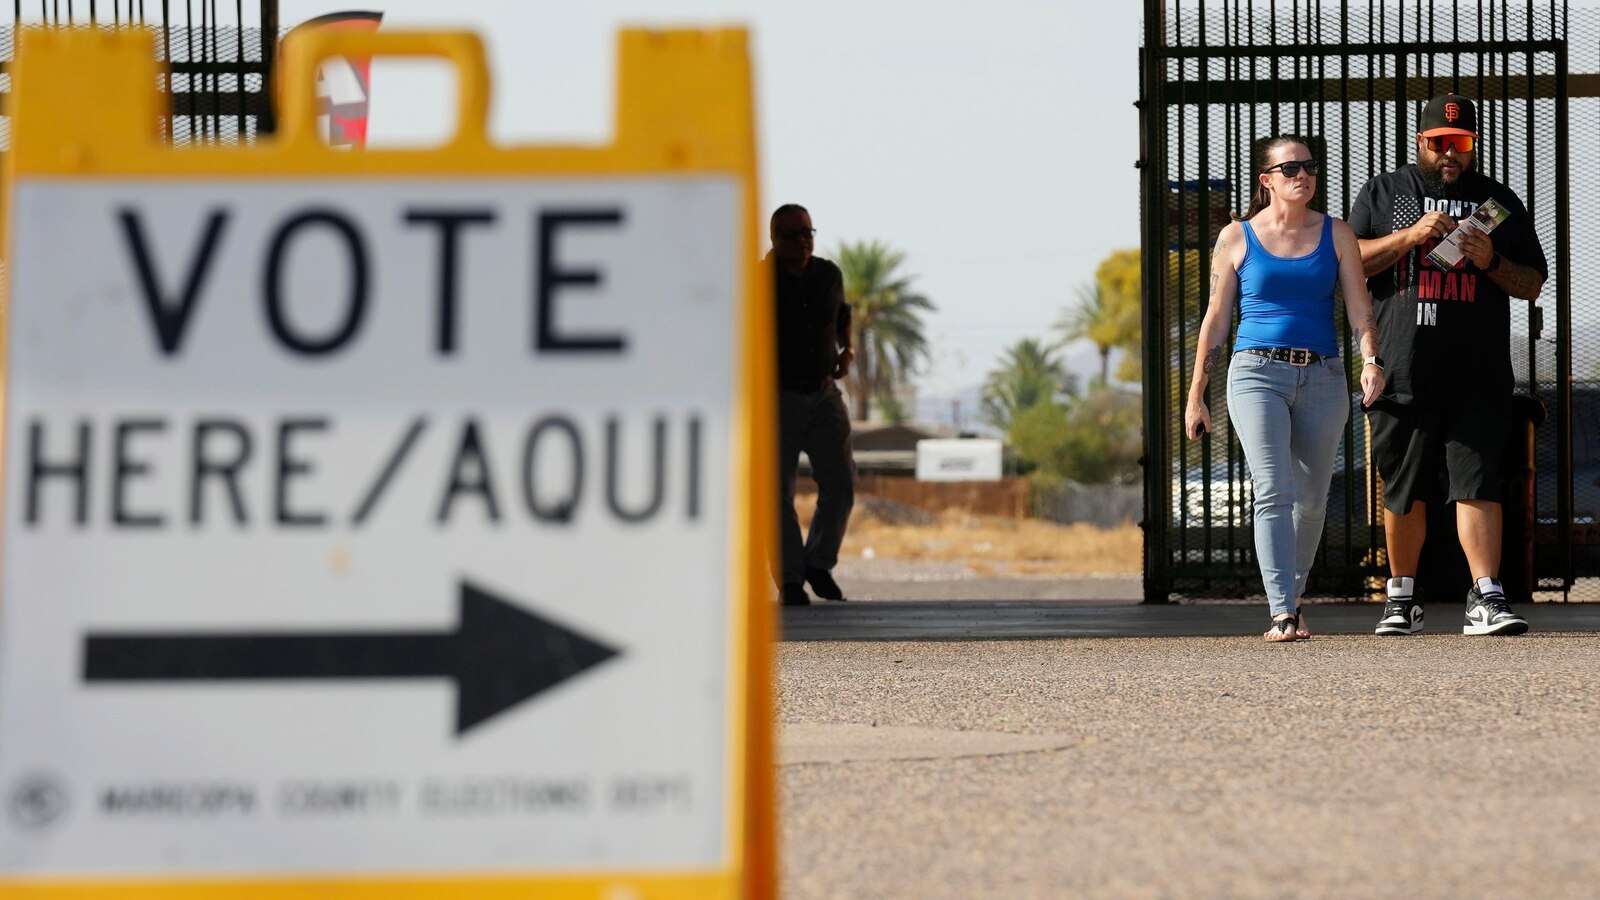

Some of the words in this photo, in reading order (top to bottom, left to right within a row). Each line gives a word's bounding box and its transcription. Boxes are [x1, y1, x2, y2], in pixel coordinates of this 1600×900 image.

[1423, 196, 1479, 217] DON'T
[112, 203, 632, 363] VOTE
[1418, 270, 1476, 303] MAN
[1416, 302, 1437, 327] IN
[23, 412, 703, 529] HERE/AQUI
